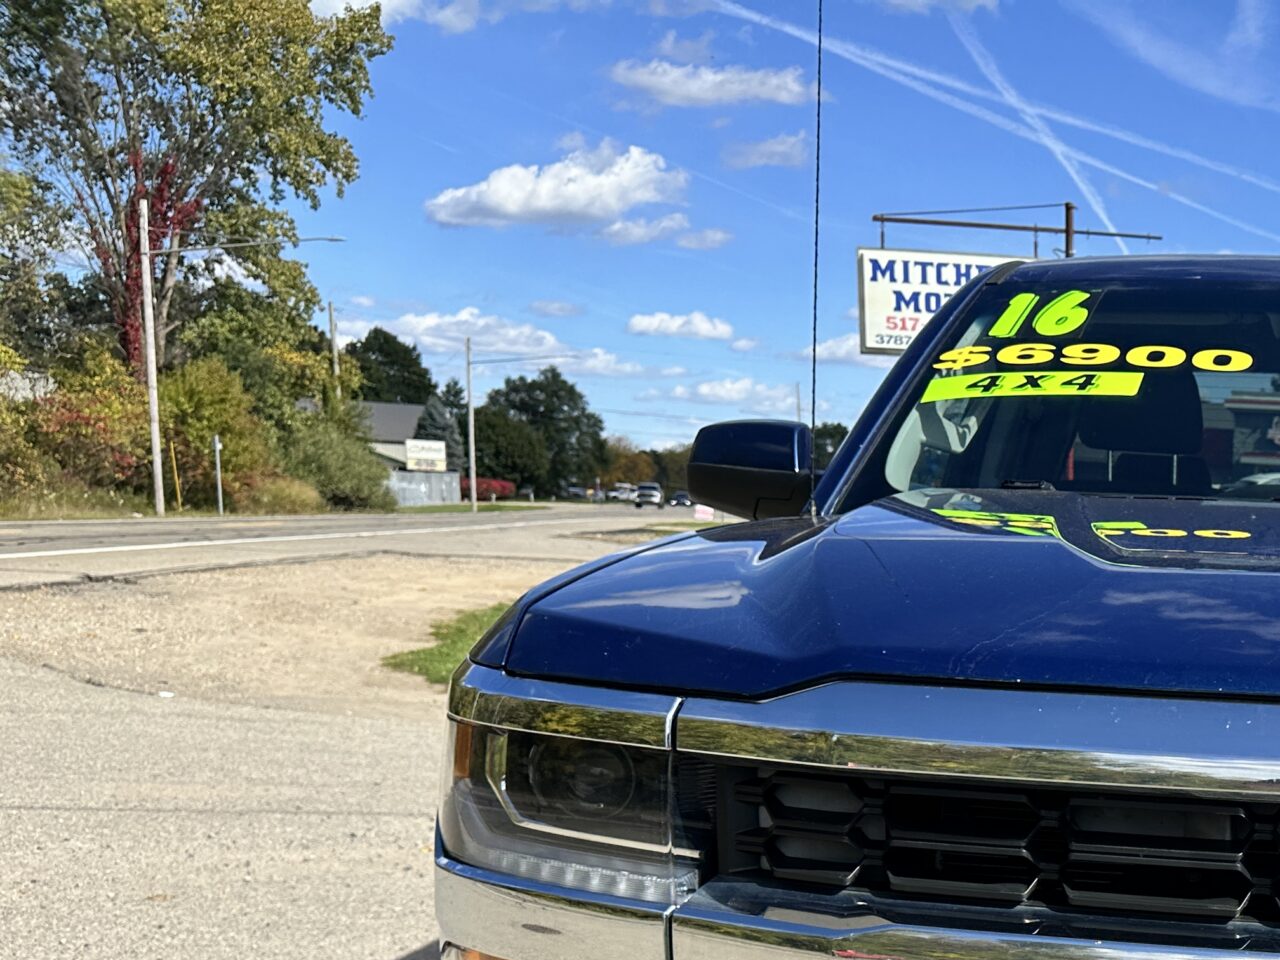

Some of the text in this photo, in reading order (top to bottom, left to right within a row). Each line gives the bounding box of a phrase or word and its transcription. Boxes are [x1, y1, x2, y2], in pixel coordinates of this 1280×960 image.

[868, 258, 992, 286] MITCH
[893, 290, 953, 313] MO
[988, 290, 1091, 337] 16
[933, 343, 1253, 371] $6900
